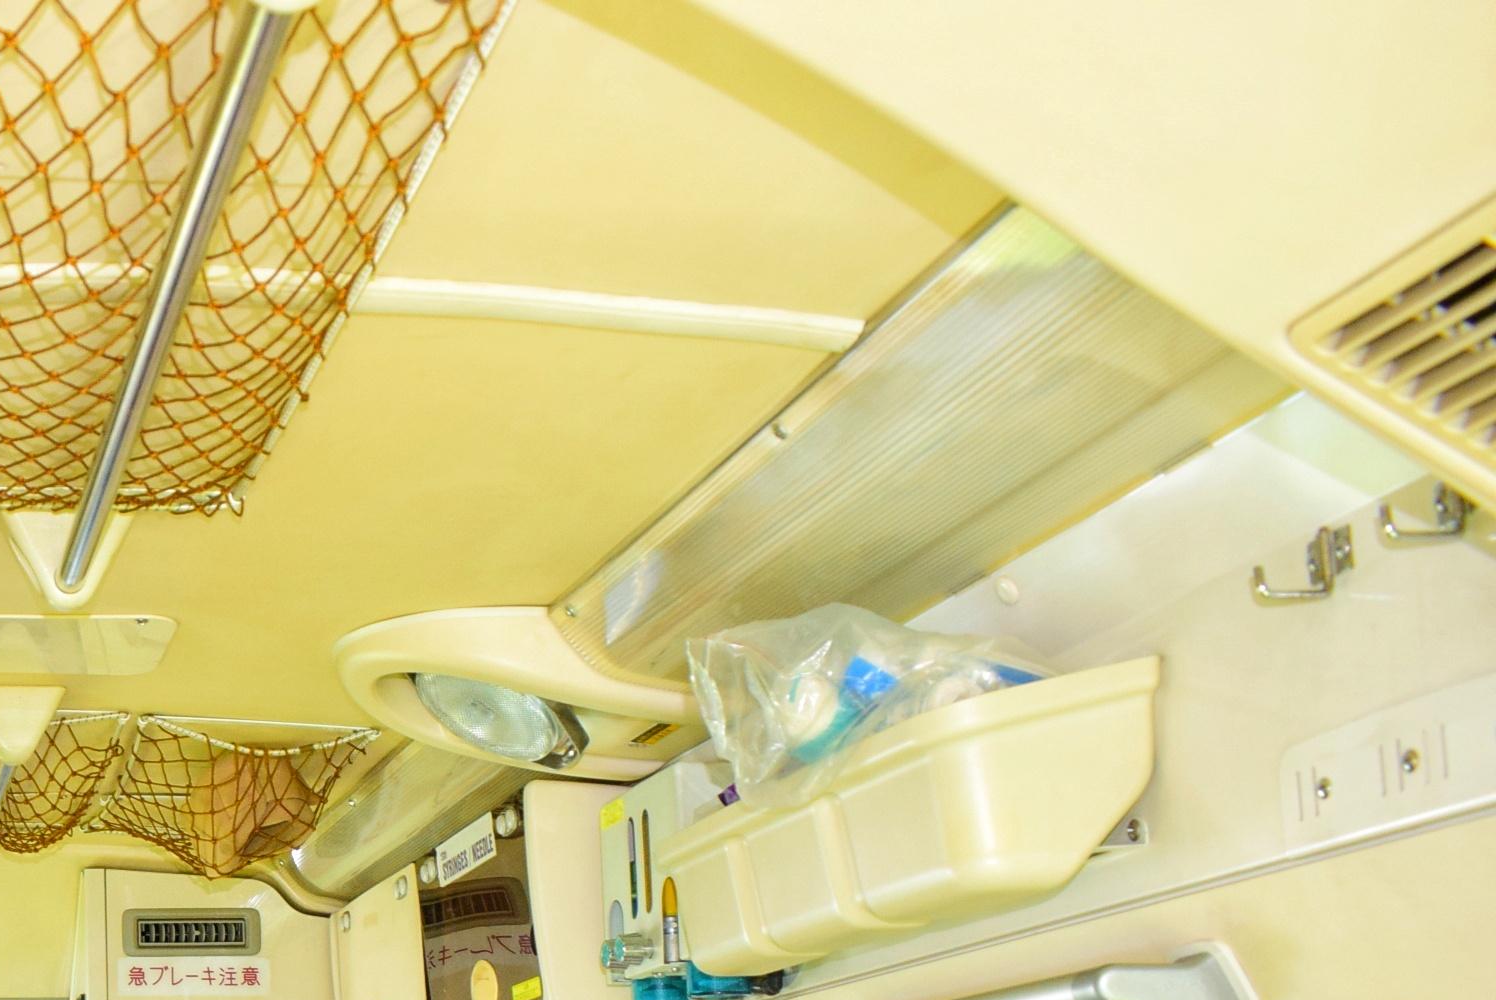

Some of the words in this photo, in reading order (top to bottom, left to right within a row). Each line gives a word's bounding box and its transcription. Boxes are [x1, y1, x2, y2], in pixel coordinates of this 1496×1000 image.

[471, 832, 494, 862] NEEDLE
[128, 965, 261, 986] 急ブレーキ注意
